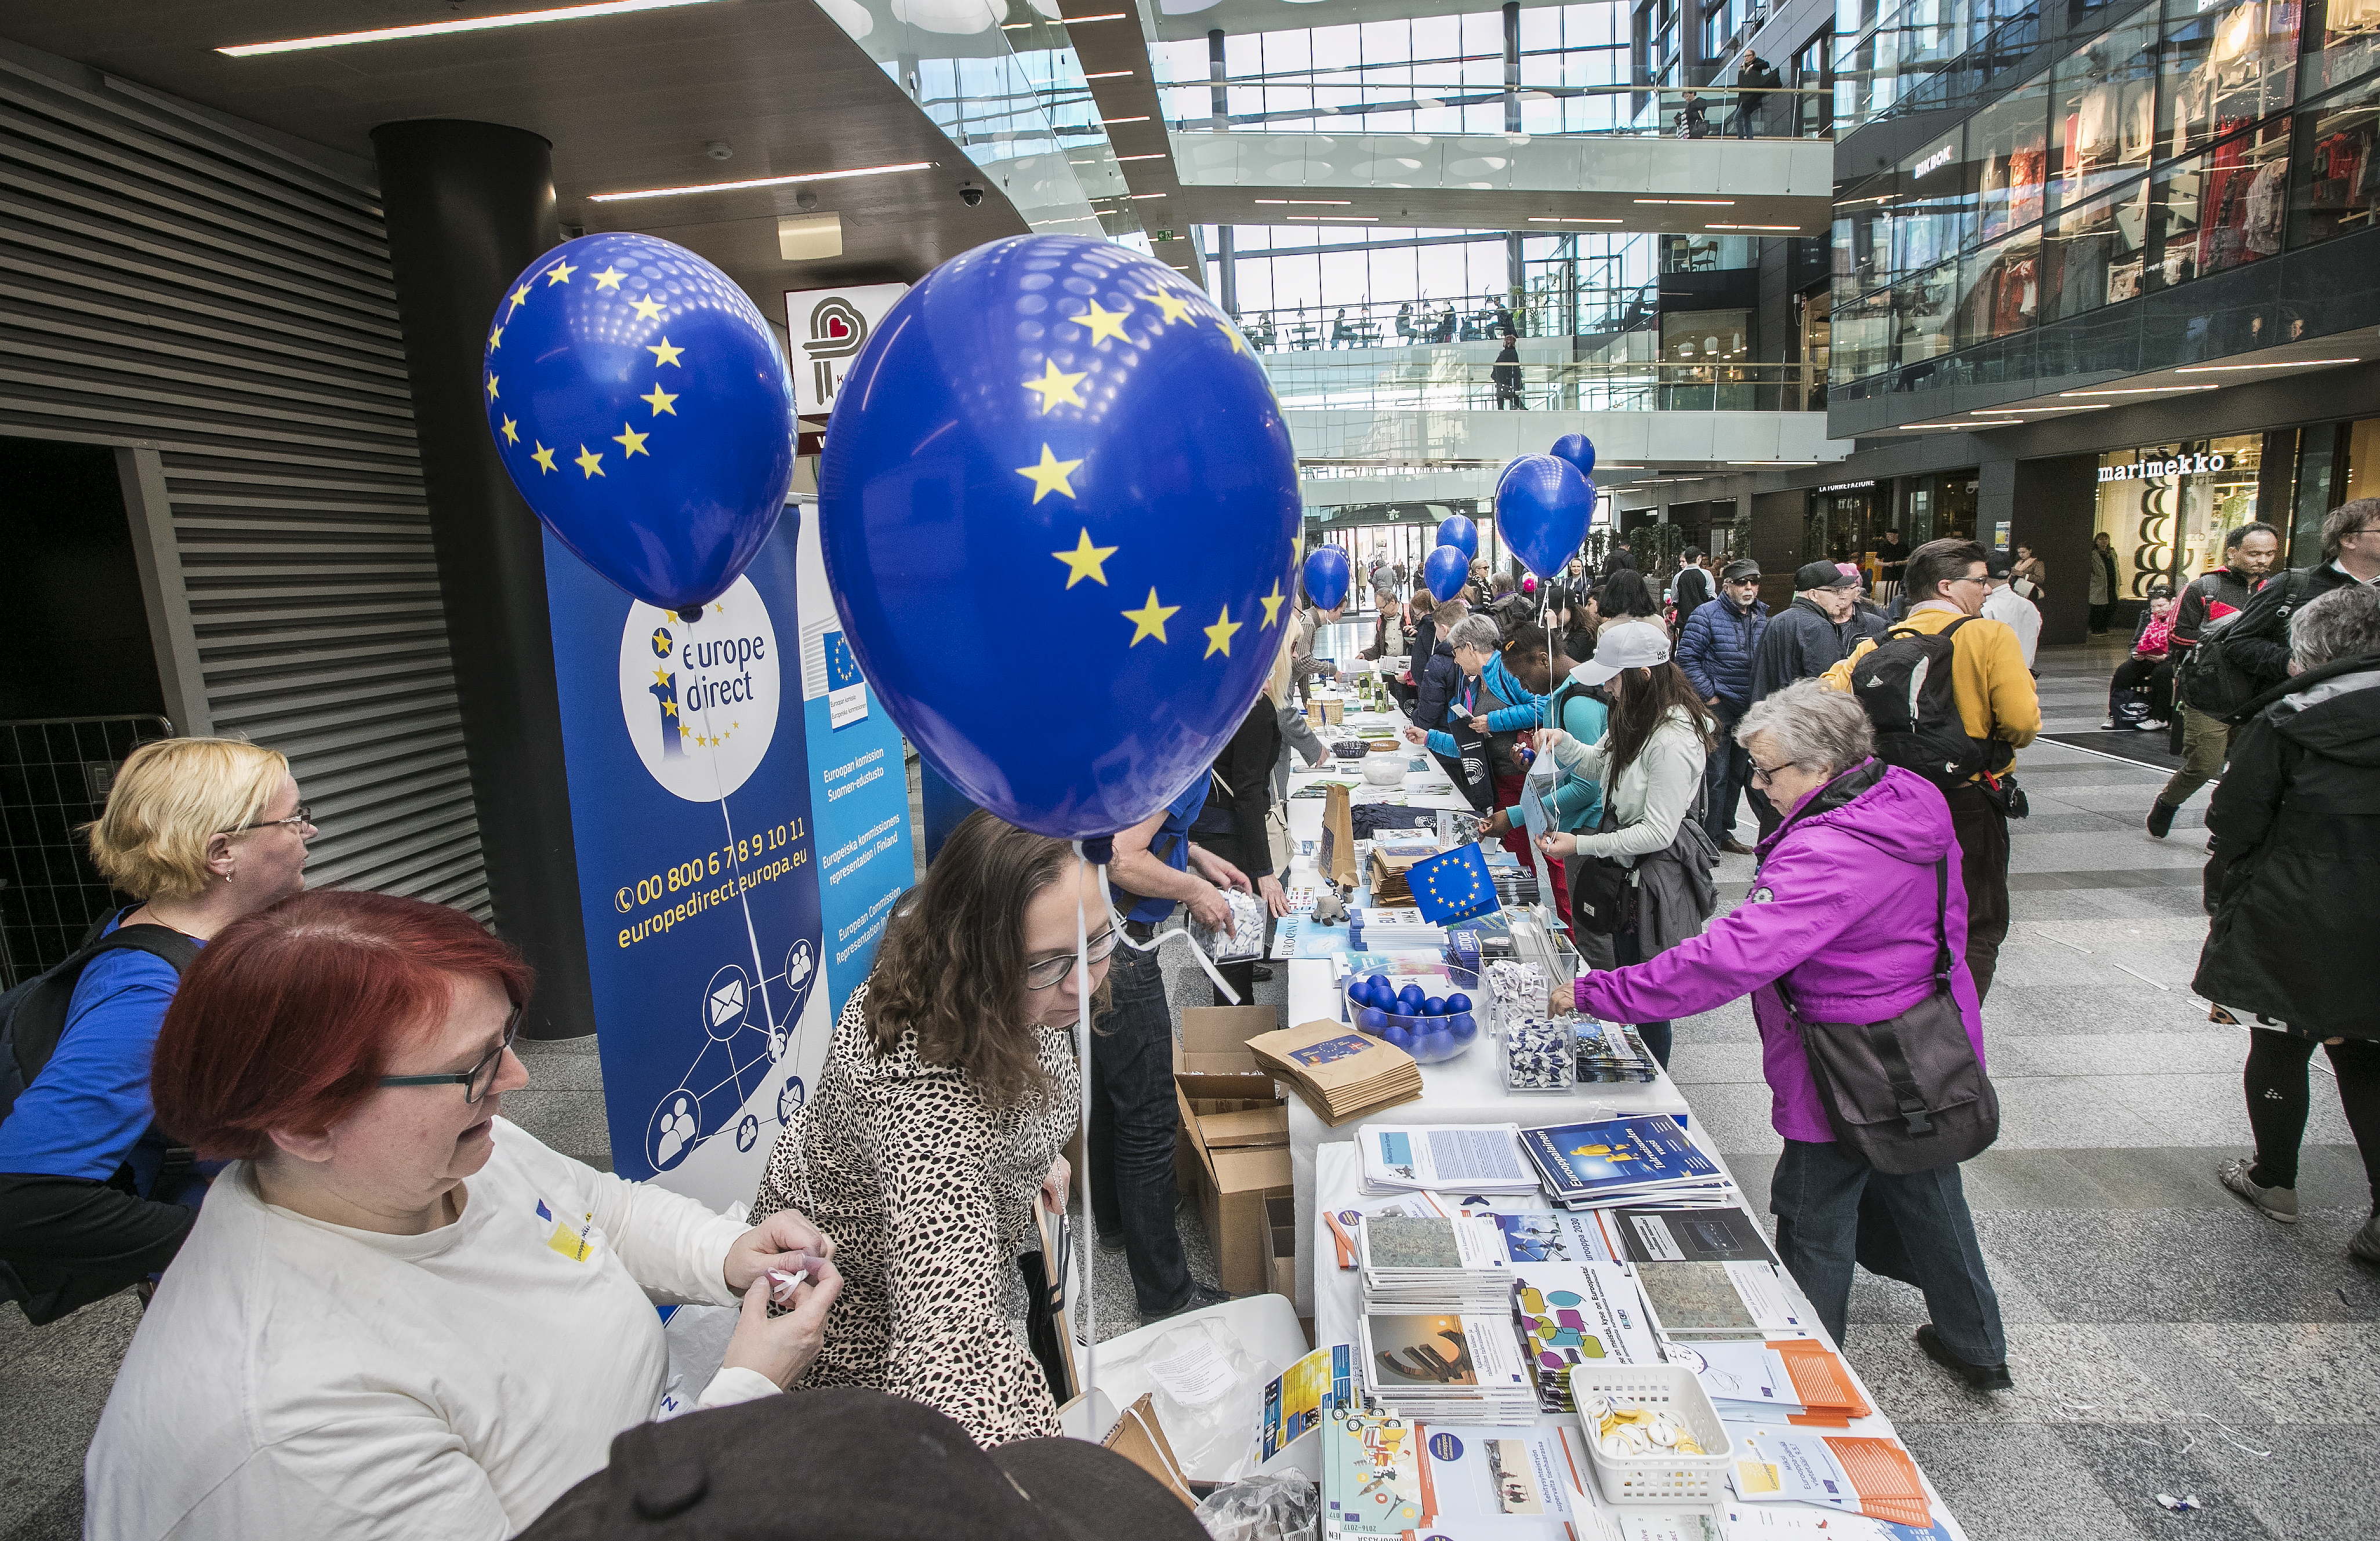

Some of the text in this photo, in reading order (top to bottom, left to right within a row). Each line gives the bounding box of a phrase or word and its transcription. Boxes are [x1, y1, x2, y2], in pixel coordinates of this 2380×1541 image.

[2098, 453, 2226, 482] marimekko
[683, 636, 765, 672] europe
[687, 671, 754, 711] direct
[830, 699, 845, 708] Euroopan
[832, 710, 848, 719] Europeiska
[823, 748, 884, 783] Euroopan komission
[828, 766, 884, 802] Suomen-edustusto
[822, 813, 900, 869] Europeiska kommissionens
[829, 831, 898, 886] representation i Finland
[637, 817, 805, 905] 00 800 6 7 8 9 10 11
[618, 848, 807, 948] europedirect.europa.eu
[839, 912, 869, 942] European
[869, 886, 901, 918] Commission
[836, 921, 880, 965] Representation
[880, 915, 887, 929] in
[1537, 1131, 1584, 1187] Eurooppalainen
[1626, 1128, 1667, 1170] Tulevaisuuden
[1649, 1140, 1667, 1155] vuosi
[1570, 1218, 1594, 1261] urooppa 2030
[1580, 1266, 1599, 1300] Euroopasta!
[1595, 1302, 1602, 1310] on
[1599, 1311, 1609, 1326] kyse
[1474, 1322, 1486, 1354] tulevaisuudesta
[1603, 1326, 1618, 1349] meistä,
[1474, 1349, 1483, 1369] Ajatuksia
[1483, 1355, 1493, 1377] rahaliiton
[1532, 1449, 1552, 1504] Kehitysyhteistyön
[1539, 1441, 1553, 1478] tienhaarassa
[1778, 1441, 1812, 1490] Eurooppa-päivää
[1779, 1455, 1793, 1471] Miksi
[1800, 1456, 1819, 1487] vietetään
[1550, 1480, 1563, 1512] supervalta
